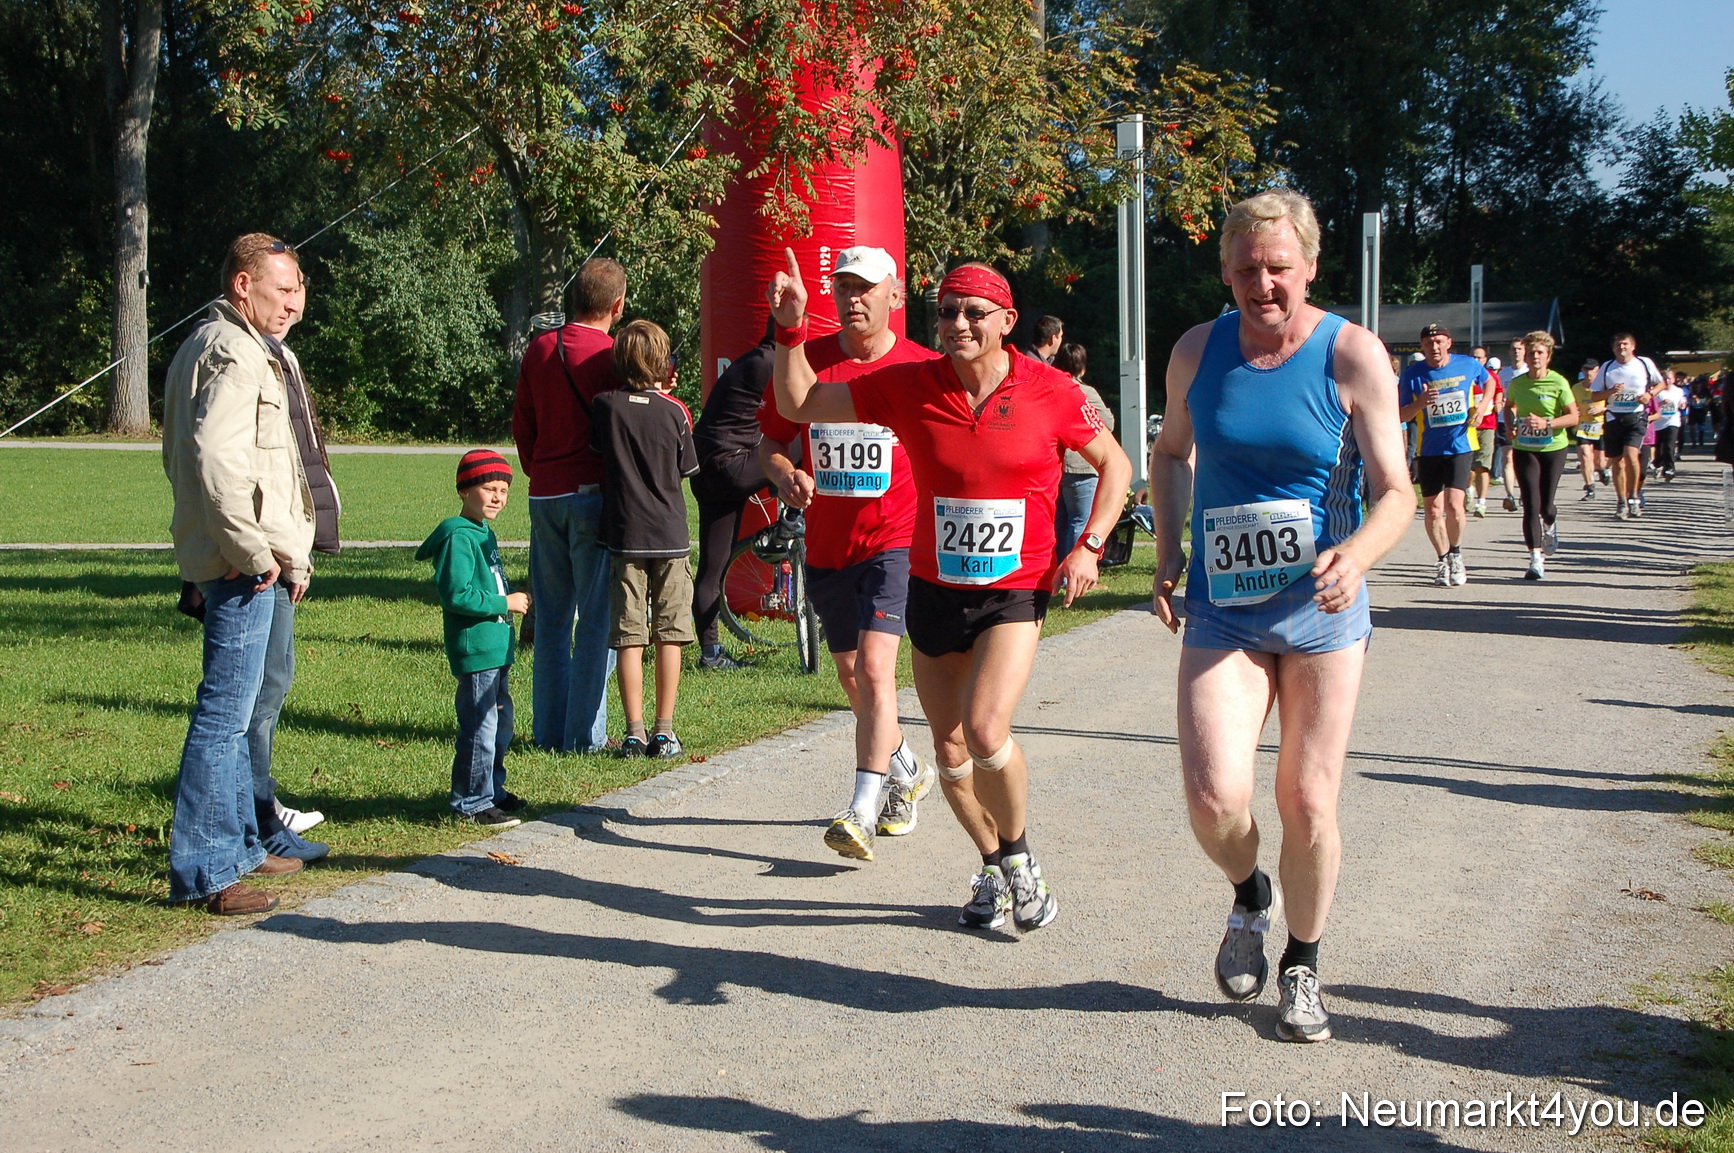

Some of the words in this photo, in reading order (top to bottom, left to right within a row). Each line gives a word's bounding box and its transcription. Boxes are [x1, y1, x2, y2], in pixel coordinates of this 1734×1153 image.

[819, 246, 831, 272] 1929
[819, 275, 831, 295] Seit
[1431, 400, 1462, 416] 2132
[820, 429, 855, 437] PFLEIDERER
[818, 442, 882, 470] 3199
[820, 471, 882, 490] Wolfgang
[945, 505, 984, 515] PFLEIDERER
[1215, 513, 1259, 527] PFLEIDERER
[943, 520, 1014, 553] 2422
[1214, 526, 1302, 571] 3403
[961, 556, 993, 573] Karl
[1234, 568, 1289, 593] André
